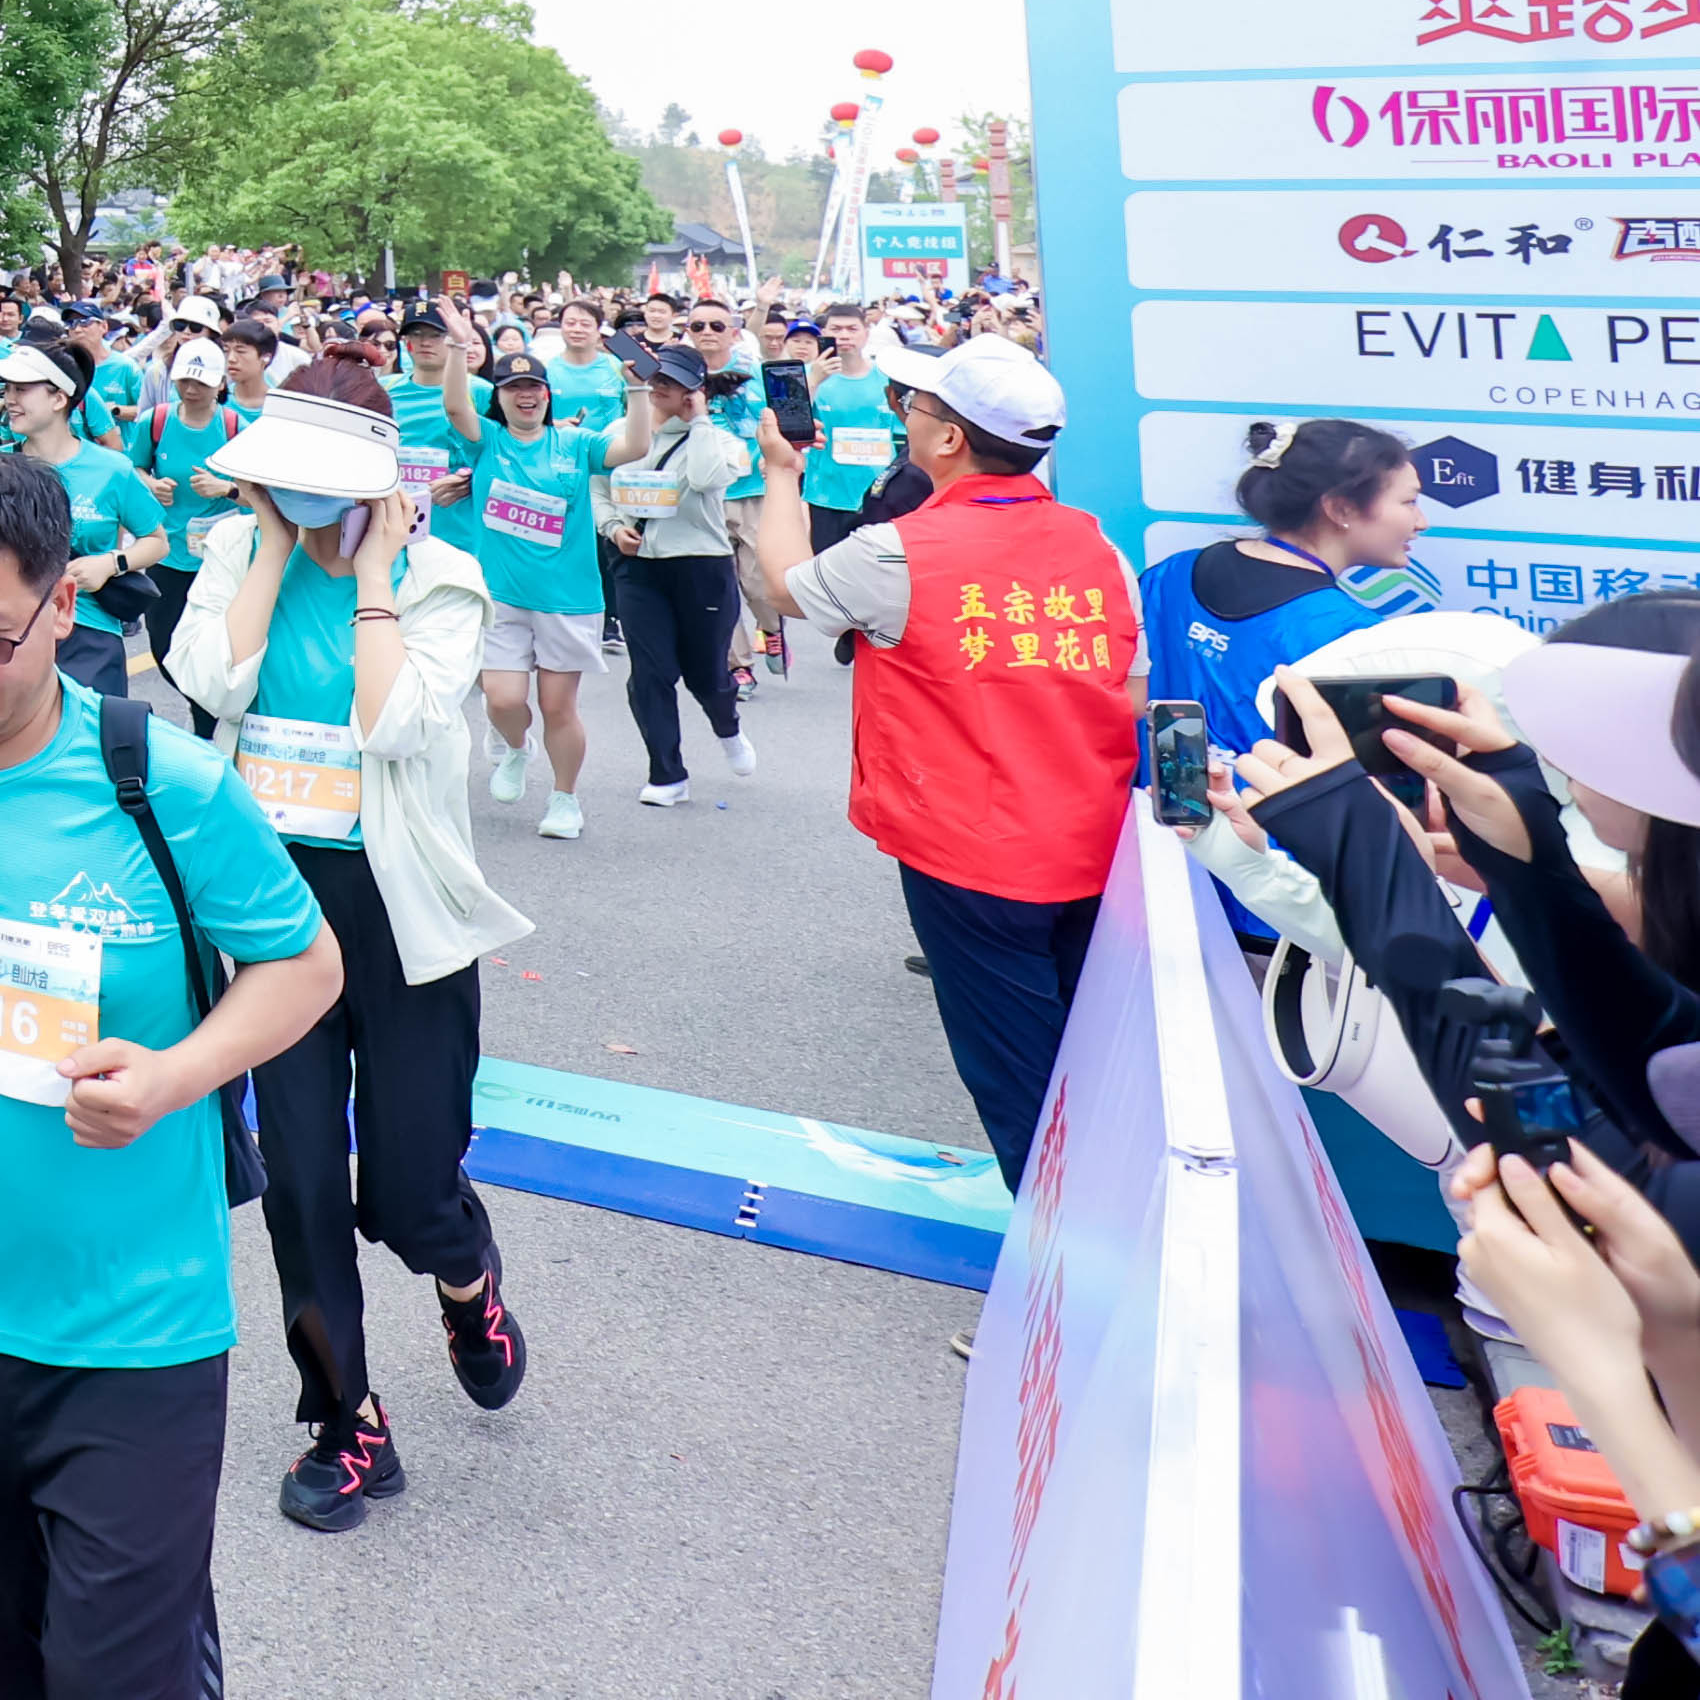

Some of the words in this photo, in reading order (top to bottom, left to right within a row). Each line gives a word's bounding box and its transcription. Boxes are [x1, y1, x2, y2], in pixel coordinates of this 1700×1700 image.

[1497, 152, 1613, 169] BAOLI
[1427, 221, 1574, 266] 仁和
[1355, 310, 1573, 362] EVITA
[1606, 314, 1700, 365] PE
[486, 500, 499, 514] C
[508, 506, 548, 528] 0181
[953, 580, 1107, 625] 孟宗故里
[958, 627, 1111, 671] 梦里花园
[244, 762, 320, 800] 0217
